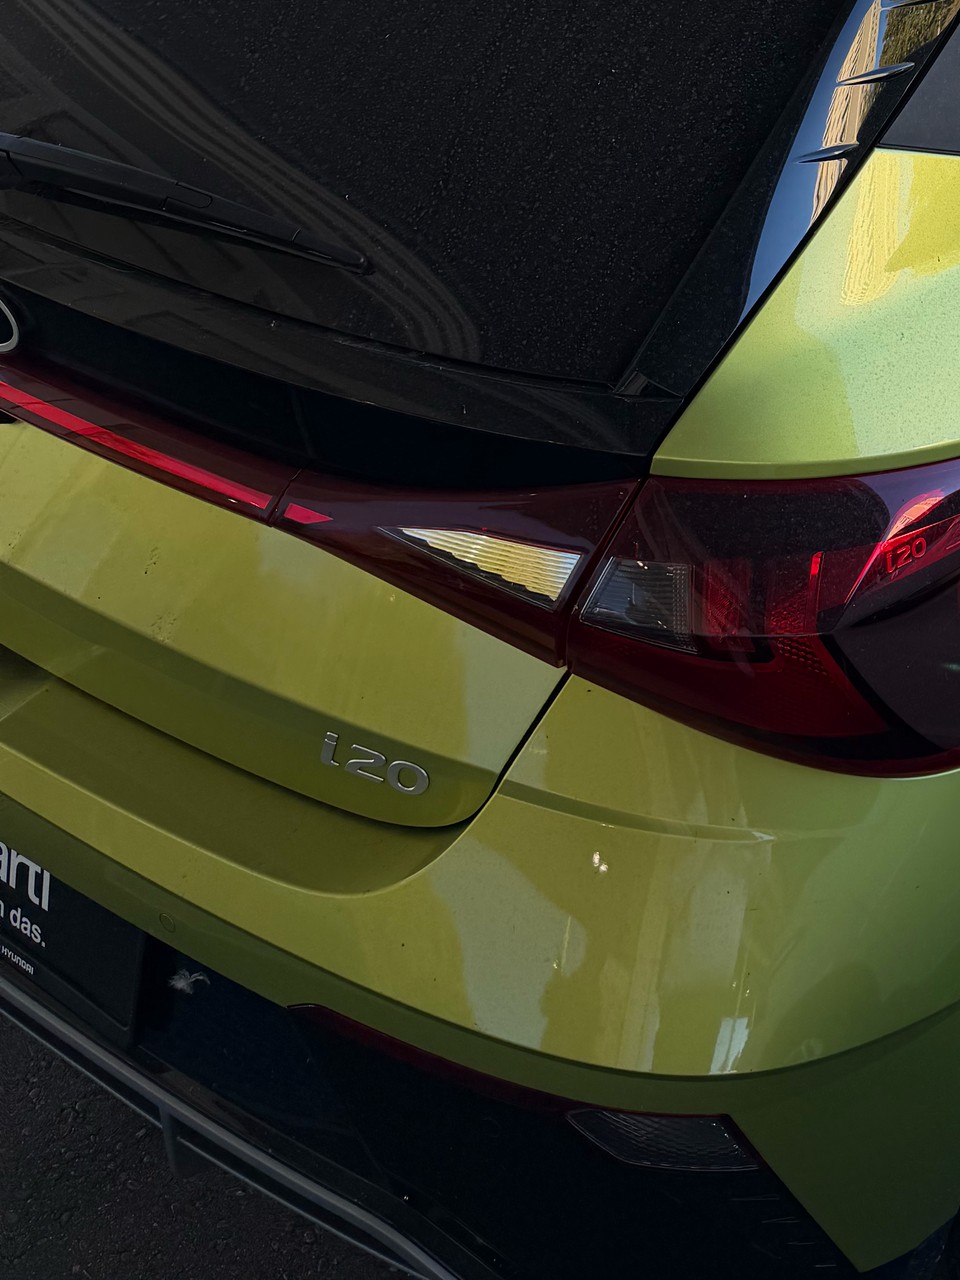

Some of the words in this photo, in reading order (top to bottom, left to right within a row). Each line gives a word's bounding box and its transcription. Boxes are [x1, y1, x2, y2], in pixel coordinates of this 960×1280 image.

[321, 731, 430, 795] i20
[10, 907, 46, 948] das.
[1, 945, 34, 976] HYUNDAI
